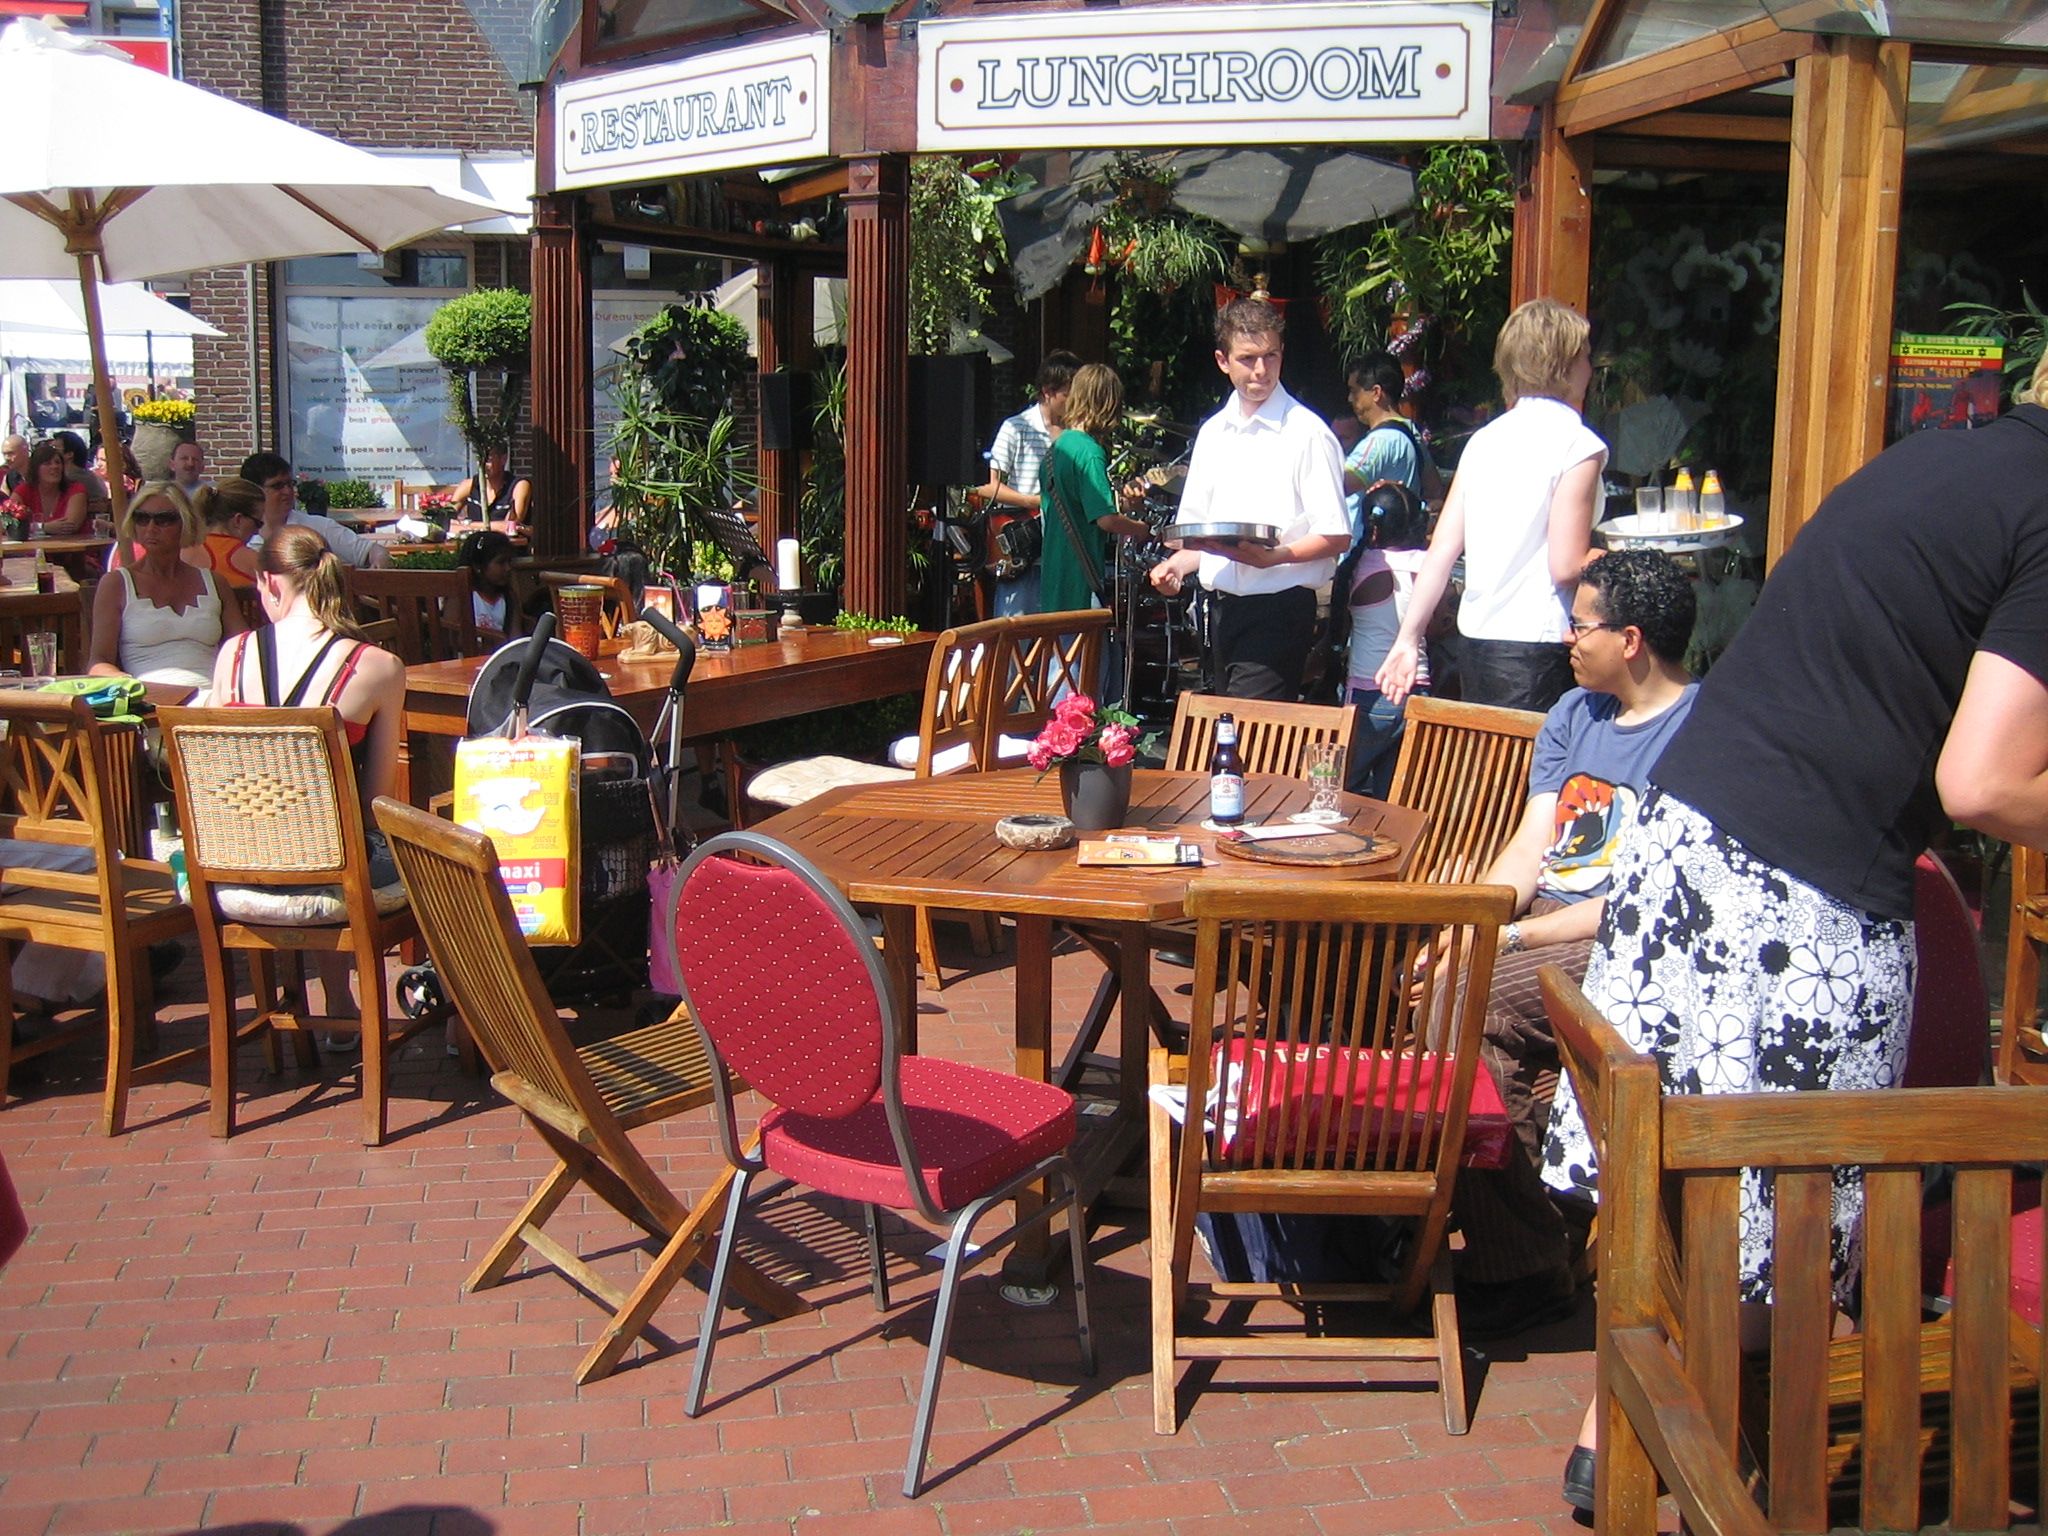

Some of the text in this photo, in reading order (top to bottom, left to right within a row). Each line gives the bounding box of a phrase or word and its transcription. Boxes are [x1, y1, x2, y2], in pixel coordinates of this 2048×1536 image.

[978, 46, 1422, 109] LUNCHROOM
[581, 77, 792, 155] RESTAURANT
[376, 445, 394, 454] met
